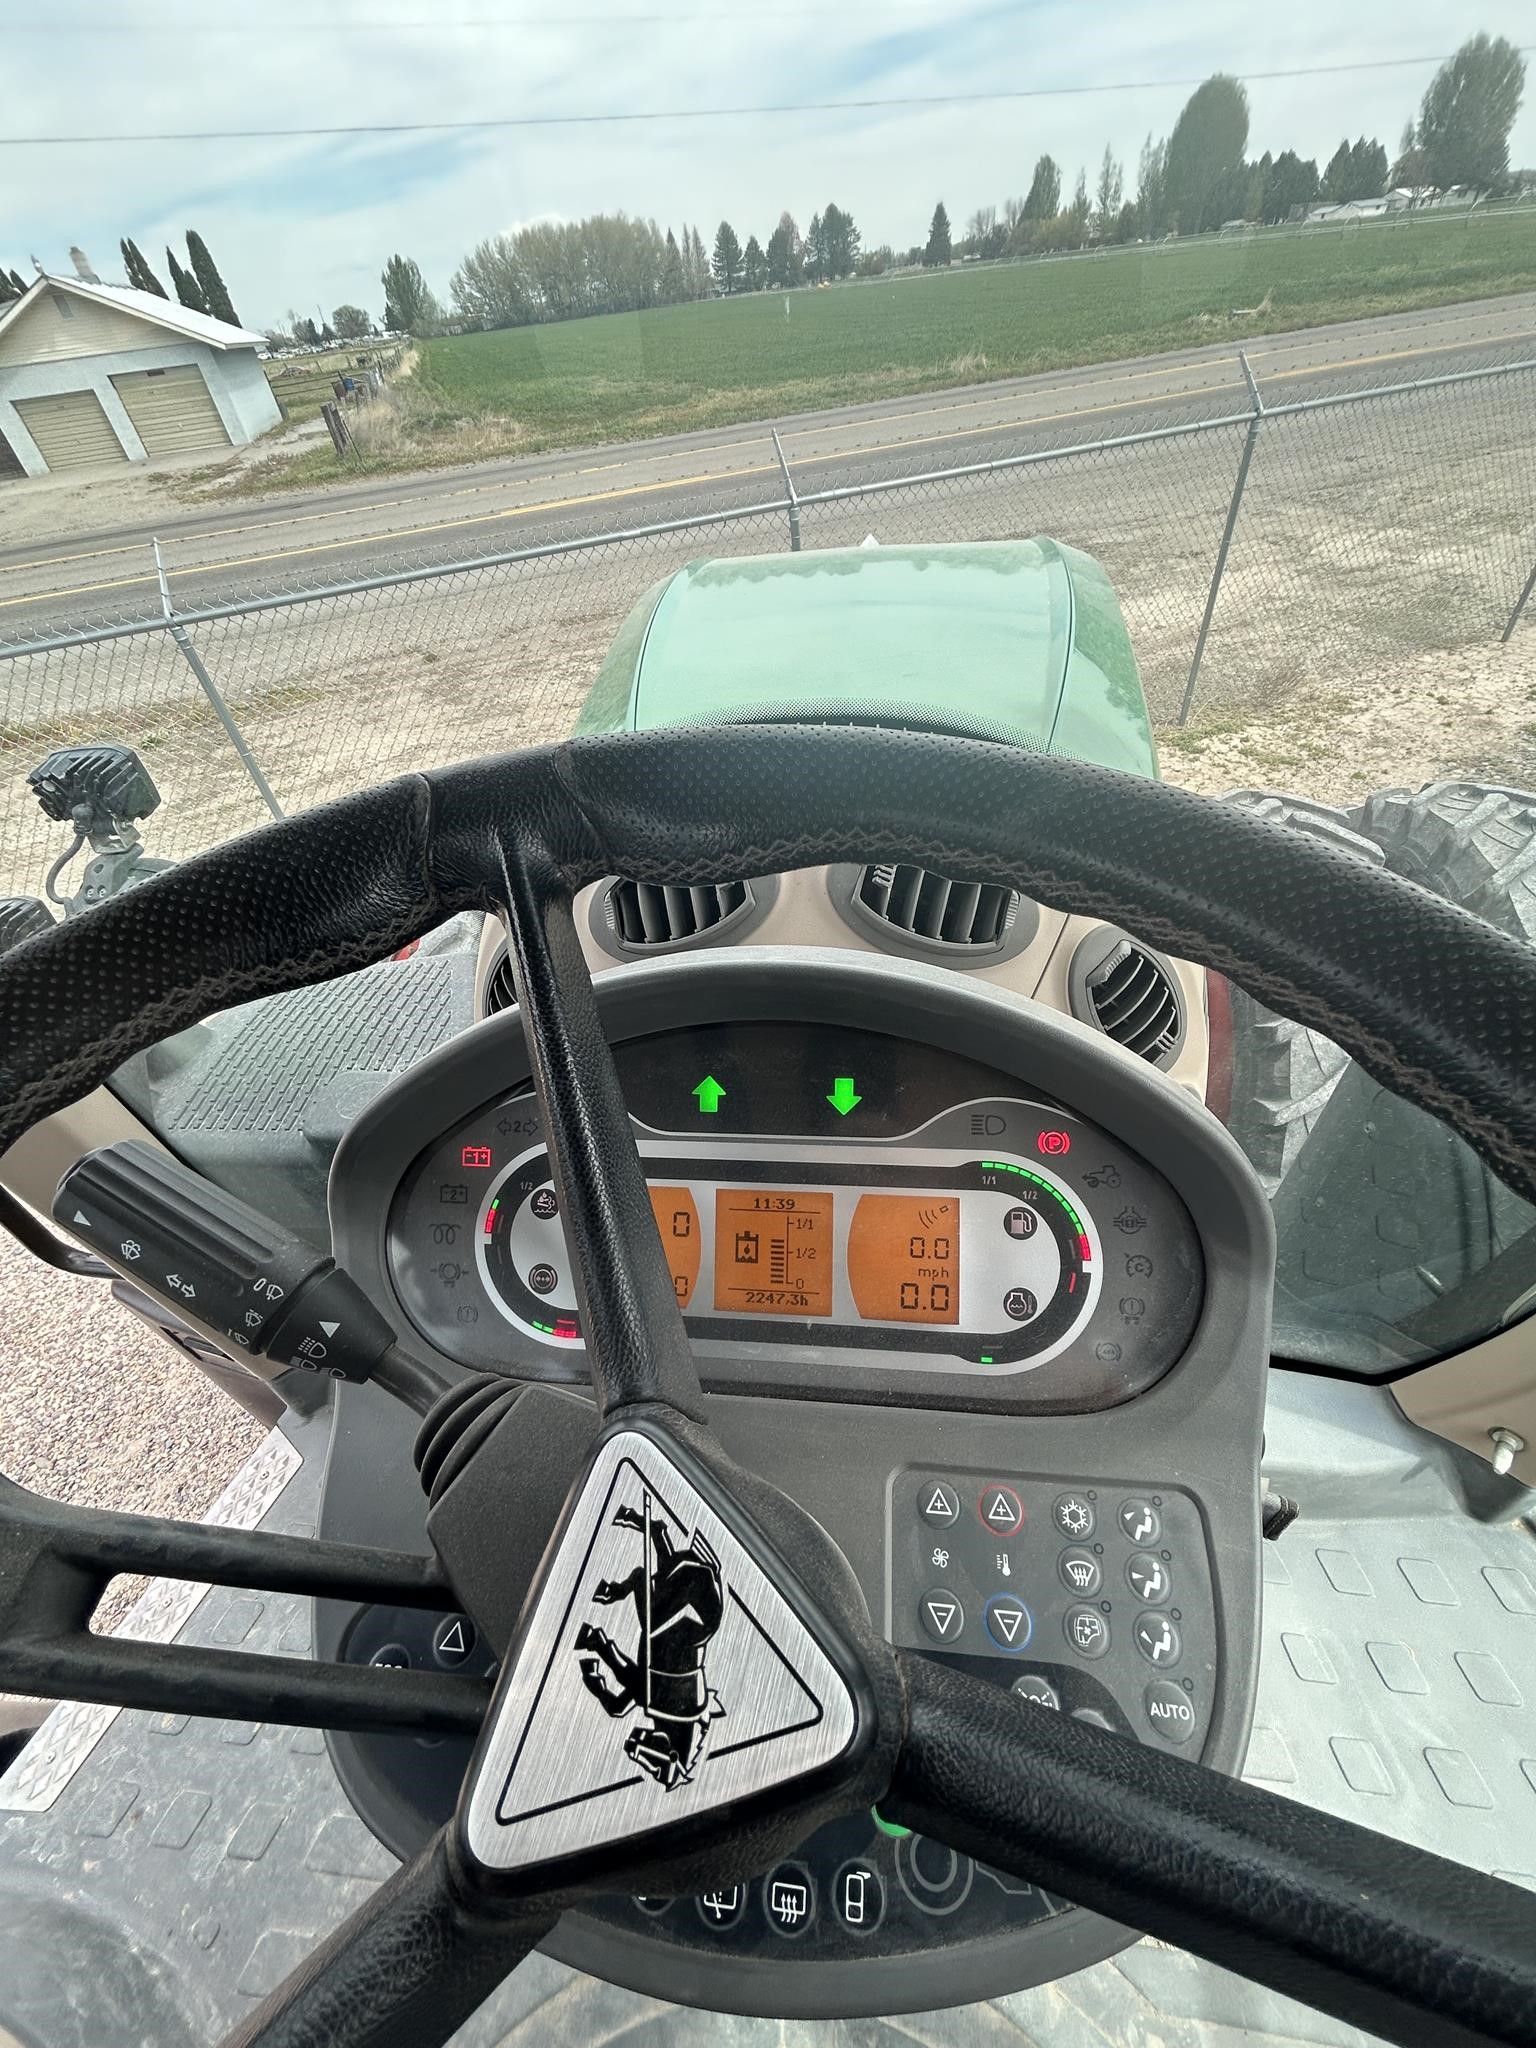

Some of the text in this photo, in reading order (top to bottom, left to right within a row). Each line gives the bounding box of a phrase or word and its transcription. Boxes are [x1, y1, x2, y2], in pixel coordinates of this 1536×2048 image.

[1047, 1136, 1061, 1149] P
[519, 1181, 534, 1191] 1/2
[982, 1175, 997, 1185] 1/1
[1022, 1190, 1038, 1200] 1/2
[754, 1197, 796, 1210] 11:39
[796, 1218, 814, 1230] 1/1
[796, 1247, 816, 1259] 1/2
[910, 1236, 949, 1260] 0.0
[918, 1267, 949, 1280] mph
[796, 1278, 804, 1290] 0
[900, 1282, 949, 1312] 0.0
[1150, 1701, 1190, 1721] AUTO
